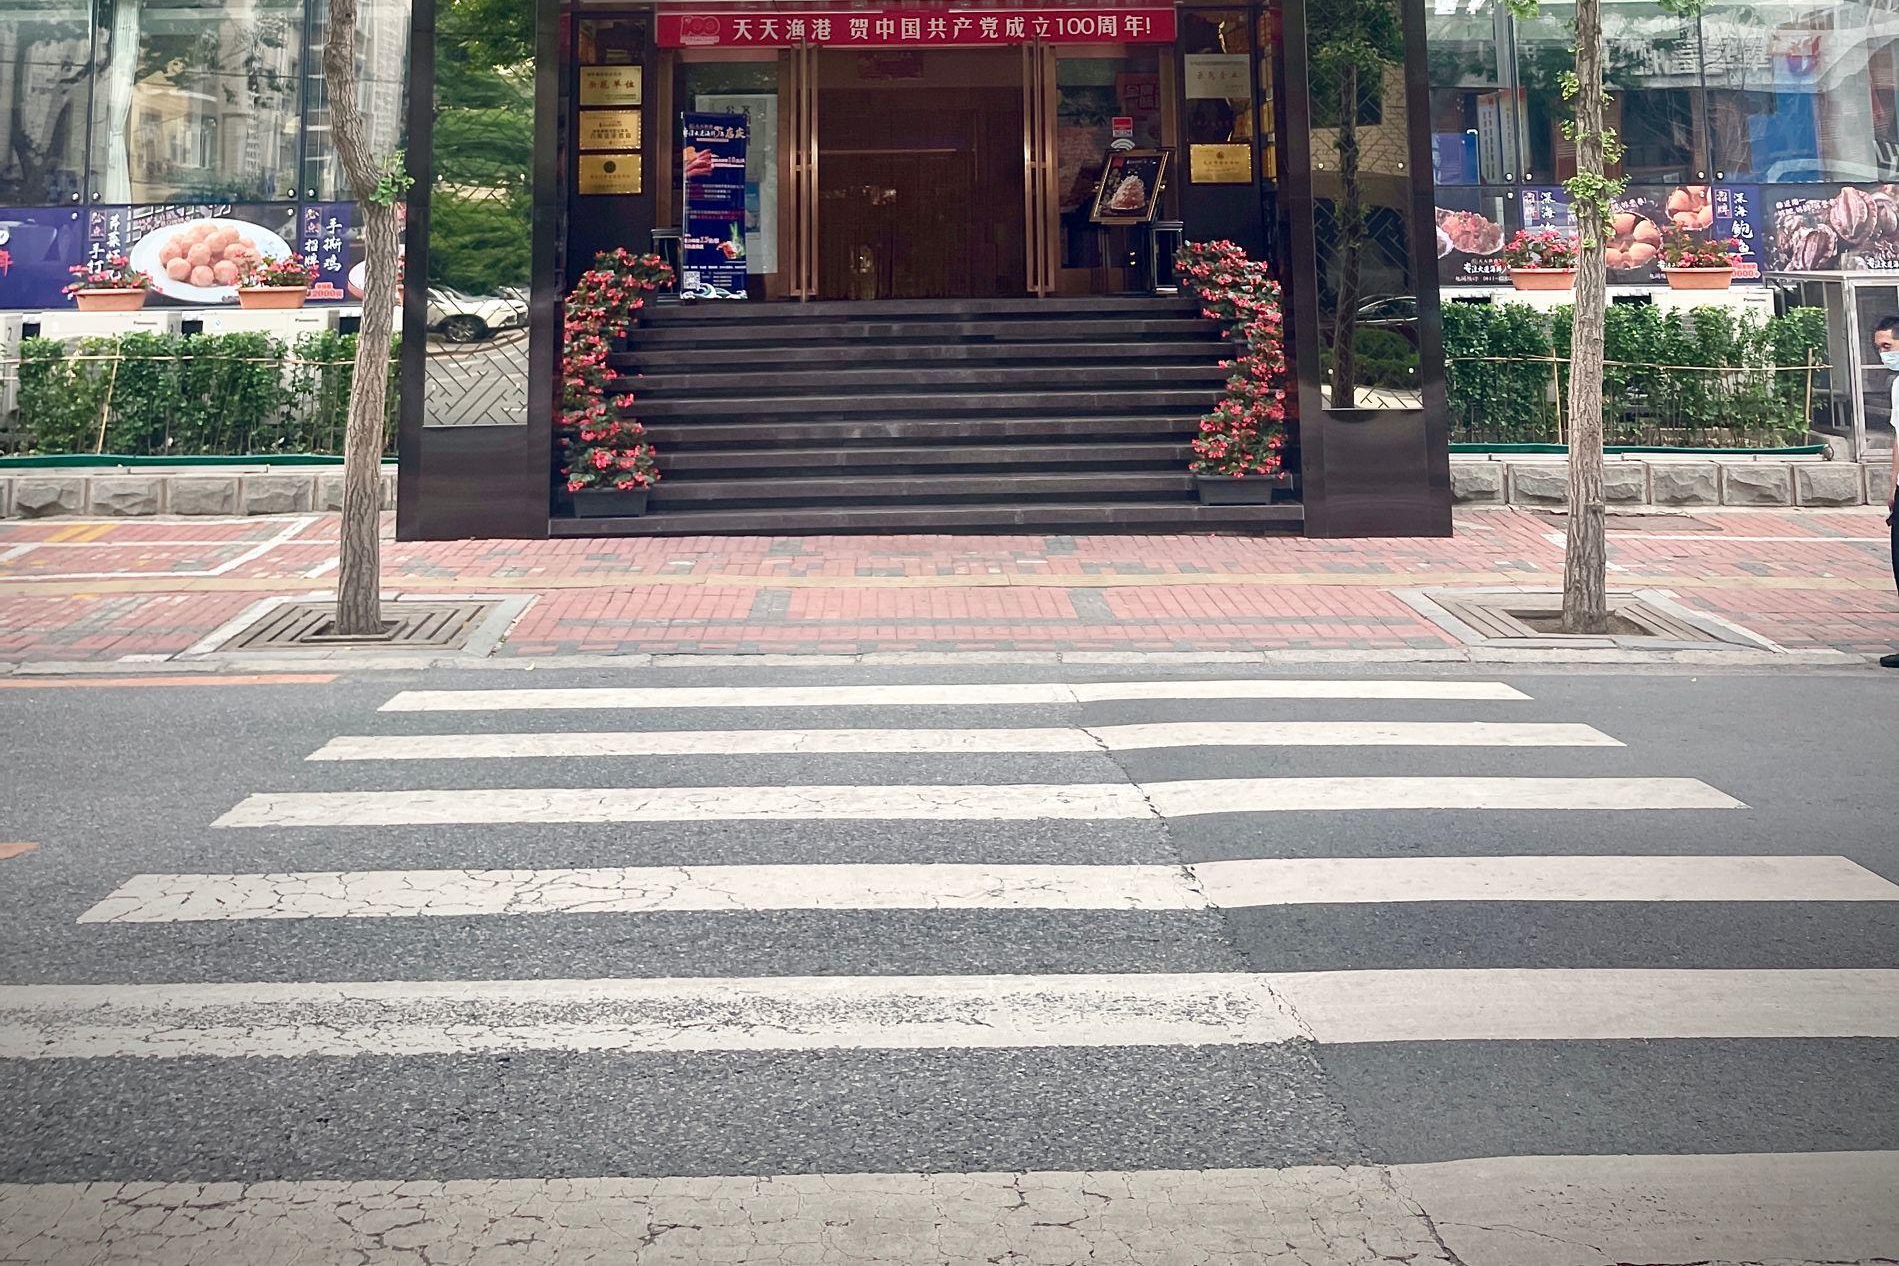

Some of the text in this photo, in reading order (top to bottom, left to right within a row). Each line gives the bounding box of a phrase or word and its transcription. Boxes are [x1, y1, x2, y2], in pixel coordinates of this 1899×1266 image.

[732, 15, 1151, 41] 天天渔港 贺中国共产党成立100周年!
[1716, 190, 1730, 217] 招牌
[1731, 192, 1755, 256] 深海鲍鱼
[304, 238, 320, 267] 招牌
[322, 217, 342, 272] 手撕鸡
